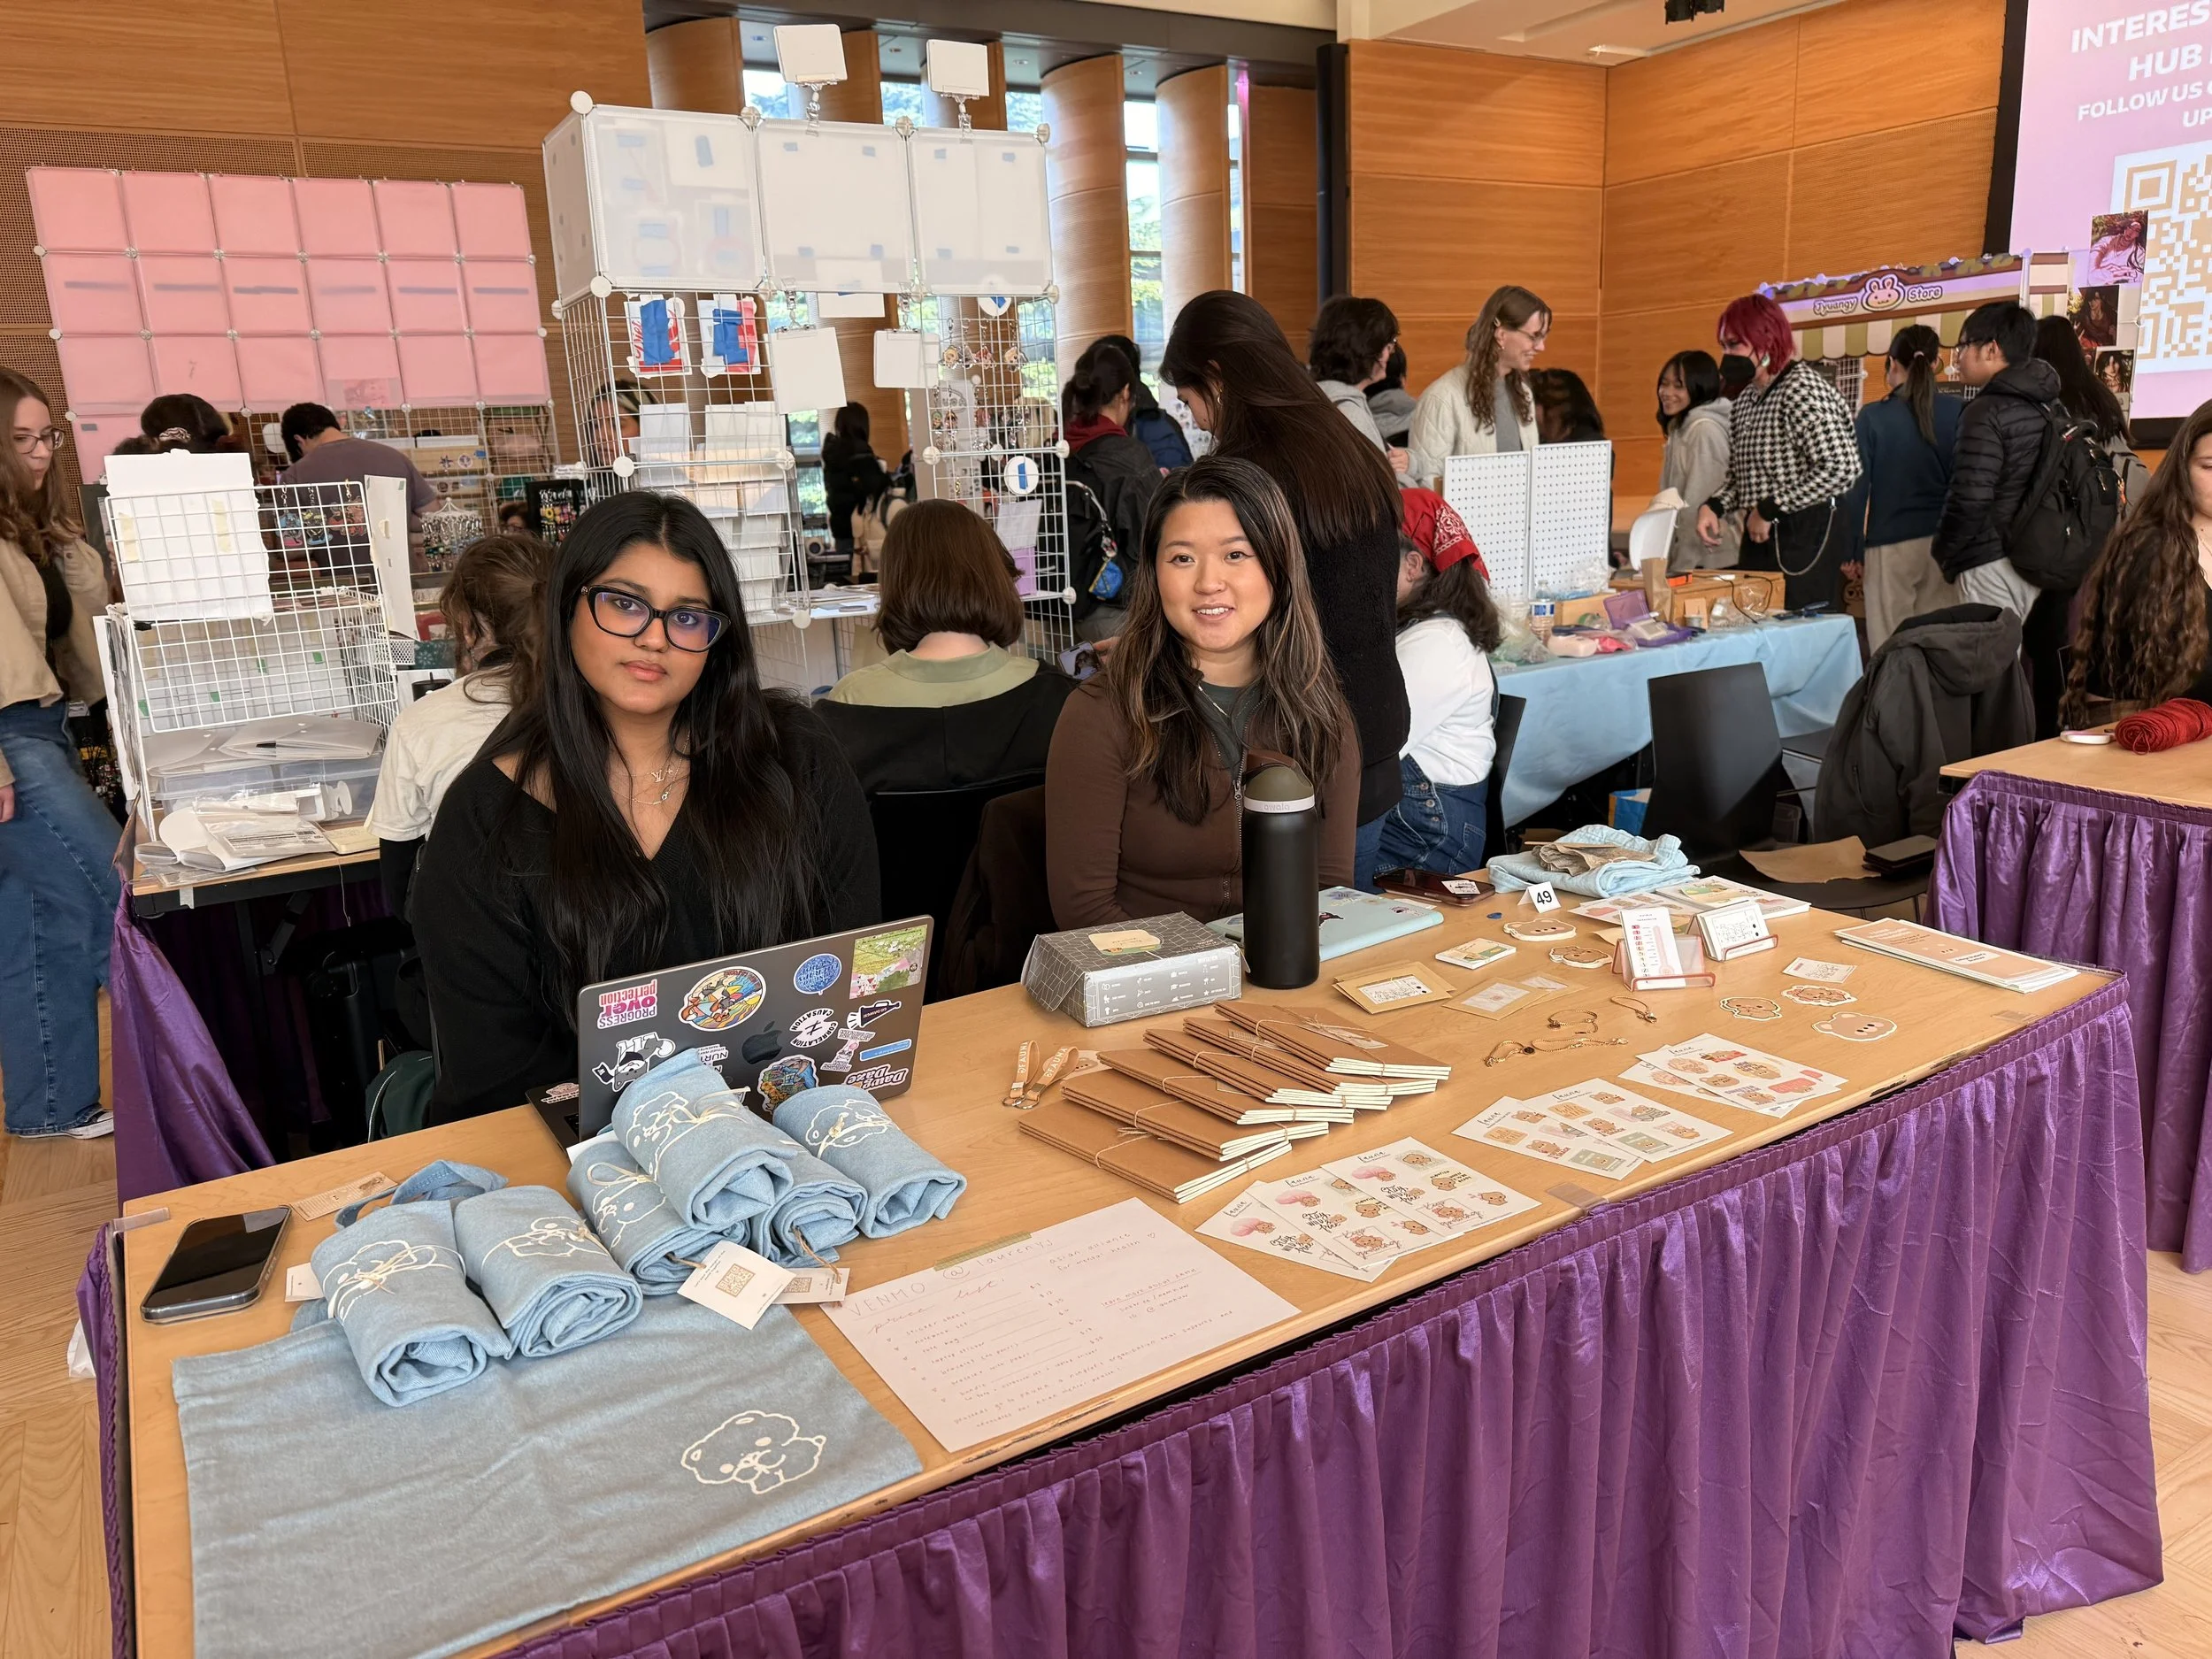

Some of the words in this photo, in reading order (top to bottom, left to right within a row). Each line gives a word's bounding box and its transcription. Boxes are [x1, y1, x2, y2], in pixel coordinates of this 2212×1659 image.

[2071, 0, 2211, 53] INTERES
[2129, 43, 2202, 81] HUB
[2078, 87, 2169, 121] FOLLOW
[2171, 81, 2202, 103] US
[2183, 107, 2212, 127] UP
[1908, 286, 1940, 301] Store
[1536, 890, 1553, 904] 49
[599, 980, 657, 1006] perfection
[599, 1006, 657, 1028] PROGRESS
[603, 996, 657, 1018] over
[791, 1009, 833, 1031] CAUSATION
[792, 1022, 838, 1048] CORRELATION
[701, 1051, 727, 1062] NURT
[849, 1065, 887, 1085] Daze
[864, 1070, 906, 1090] Dawg
[1380, 1184, 1409, 1195] Stay
[1302, 1210, 1331, 1223] Stay
[1270, 1233, 1297, 1248] Stay
[849, 1282, 926, 1317] VENMO
[942, 1265, 971, 1280] @
[868, 1305, 934, 1335] price
